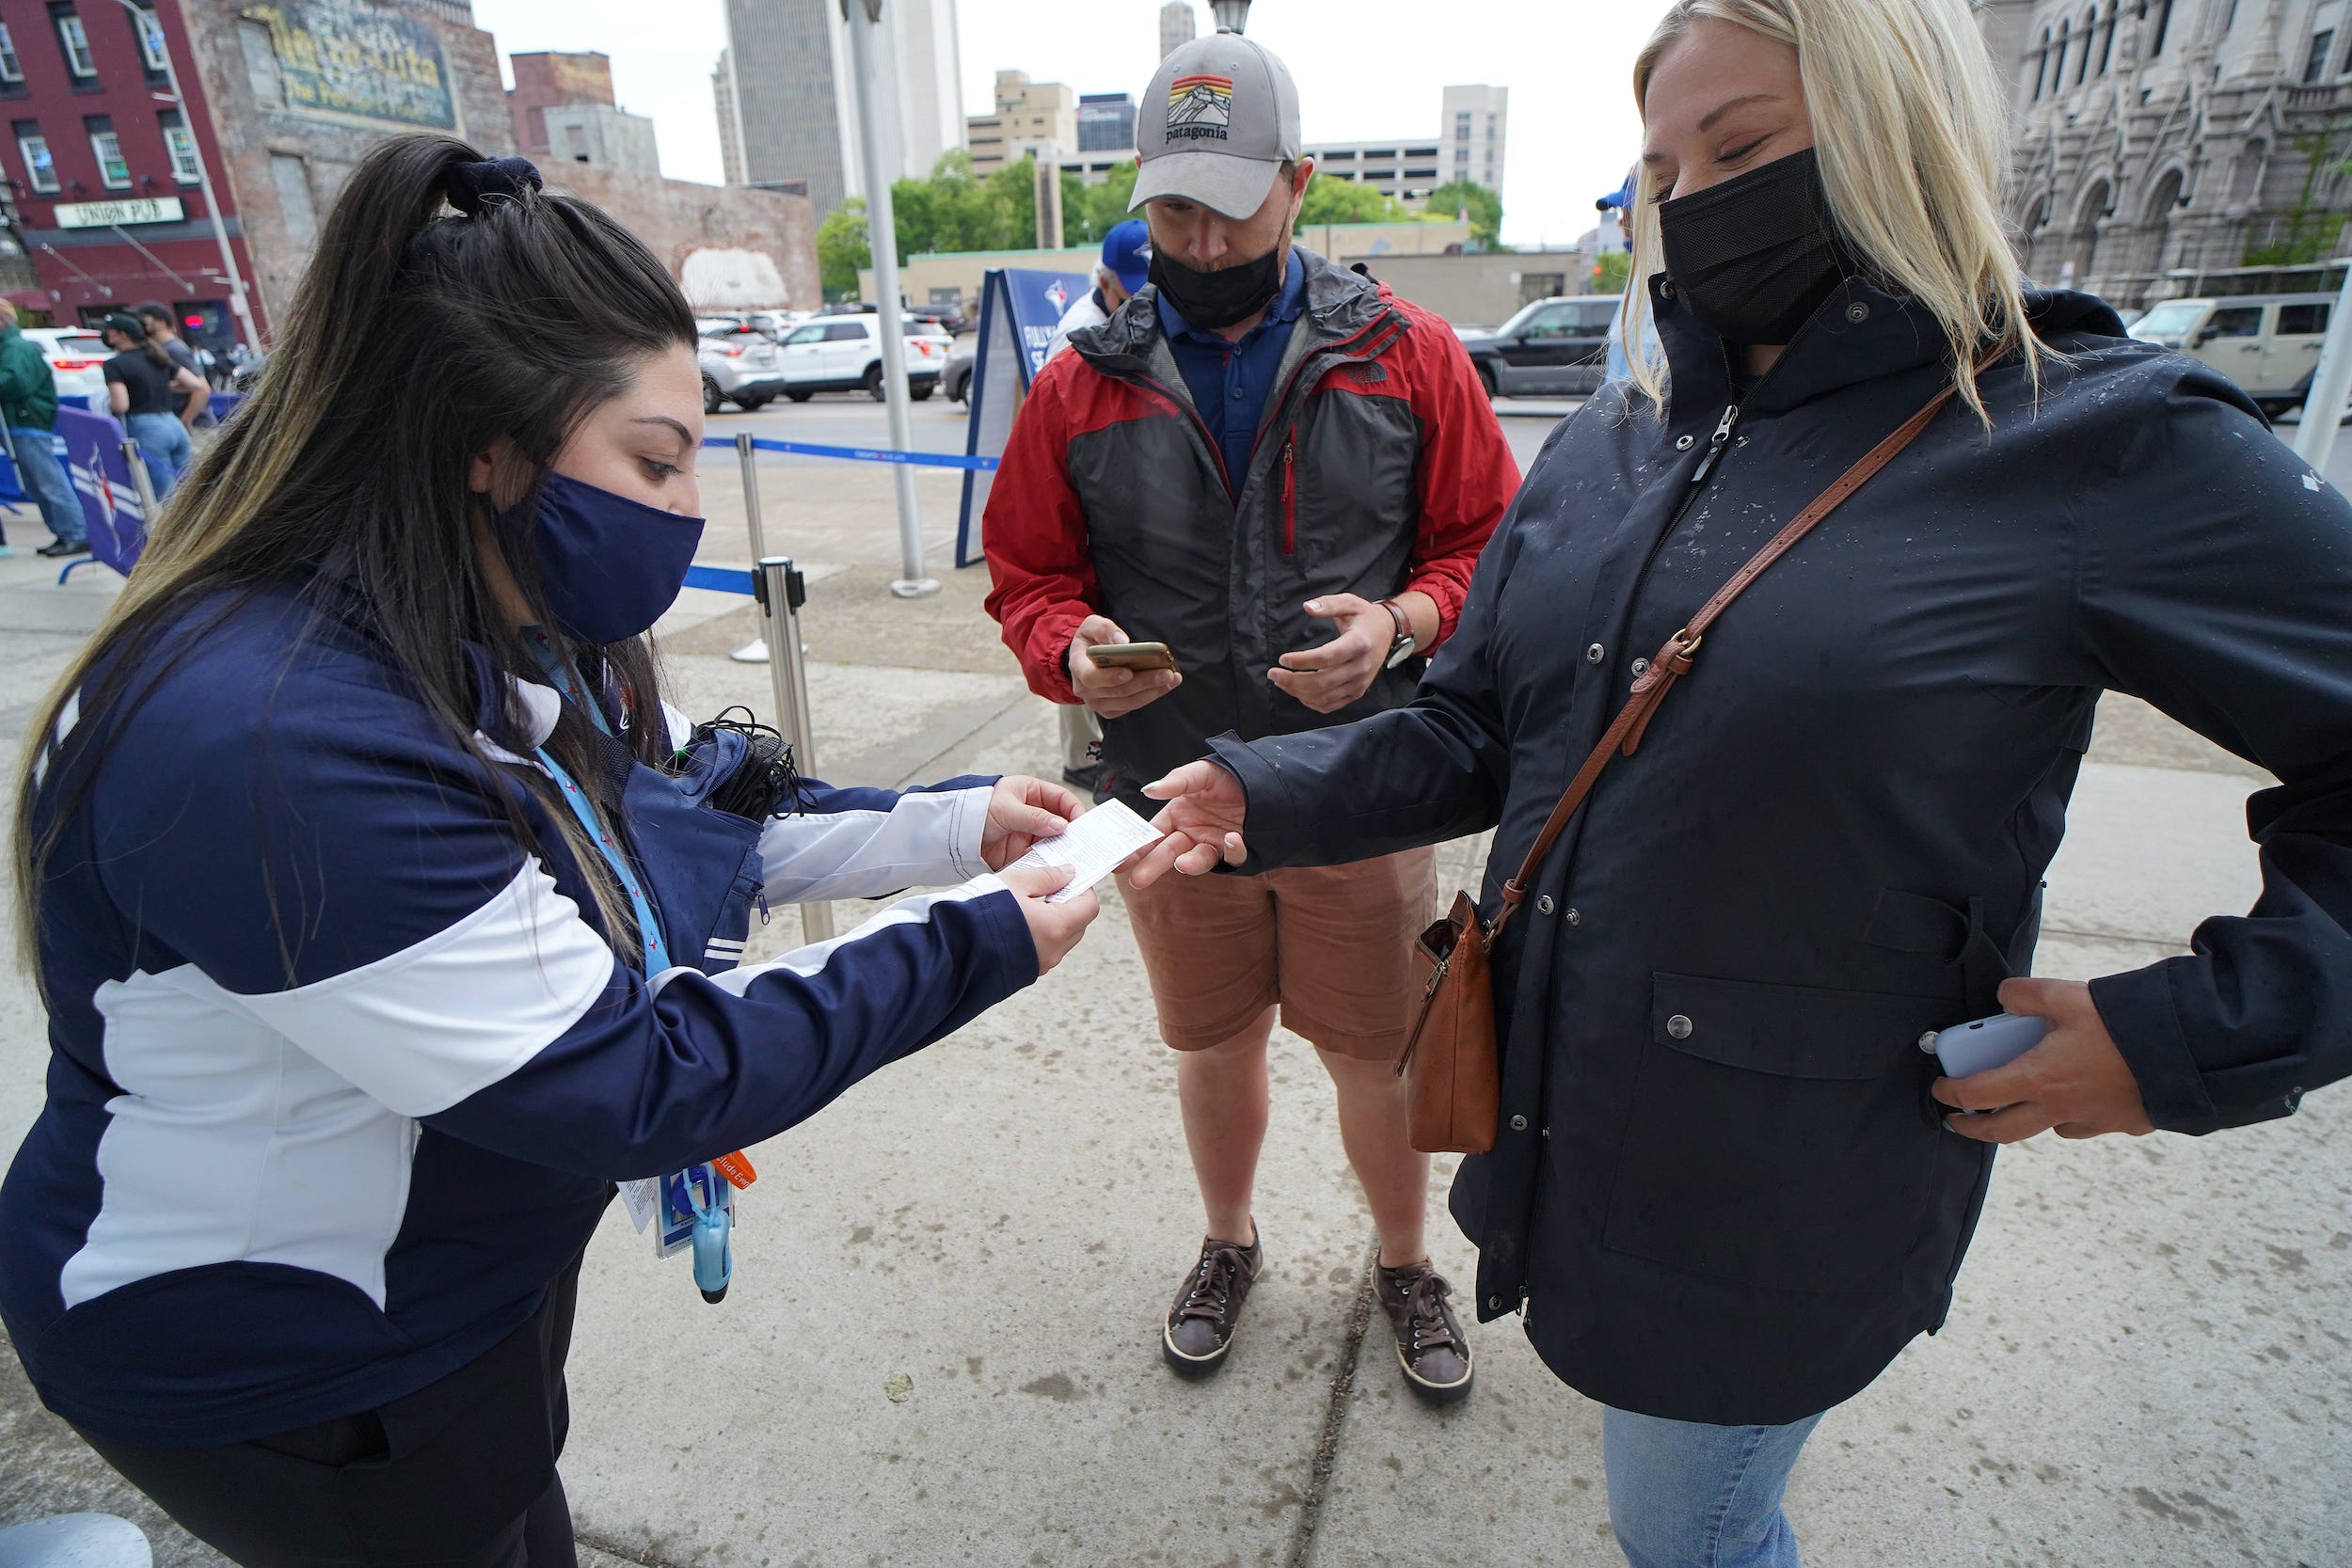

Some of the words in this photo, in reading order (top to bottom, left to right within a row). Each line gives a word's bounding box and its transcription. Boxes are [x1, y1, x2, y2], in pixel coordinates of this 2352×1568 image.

[1166, 125, 1228, 145] patagonia
[75, 201, 125, 226] UNION
[131, 198, 163, 222] PUB
